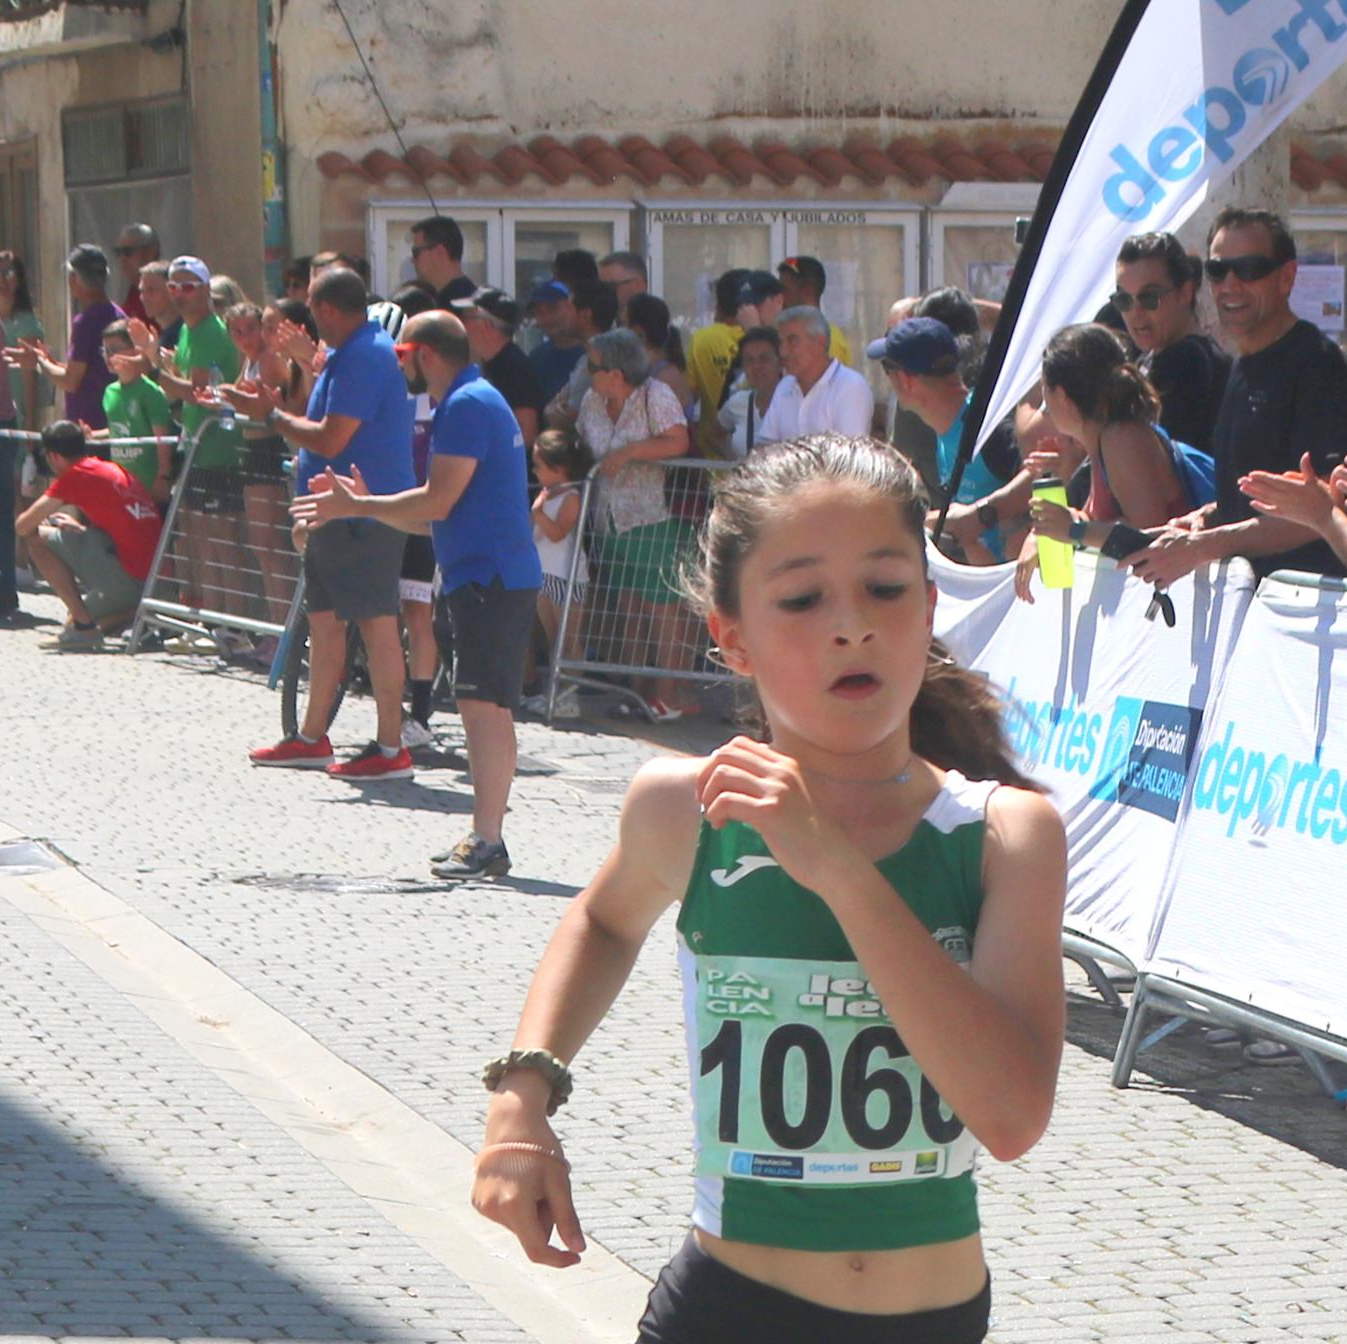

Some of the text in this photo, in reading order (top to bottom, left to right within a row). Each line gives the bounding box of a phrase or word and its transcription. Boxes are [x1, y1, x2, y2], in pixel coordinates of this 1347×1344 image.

[653, 211, 867, 224] AMAS DE CASA Y JUBILADOS
[707, 968, 759, 985] PA
[708, 984, 771, 1000] LEN
[707, 1000, 773, 1016] CIA
